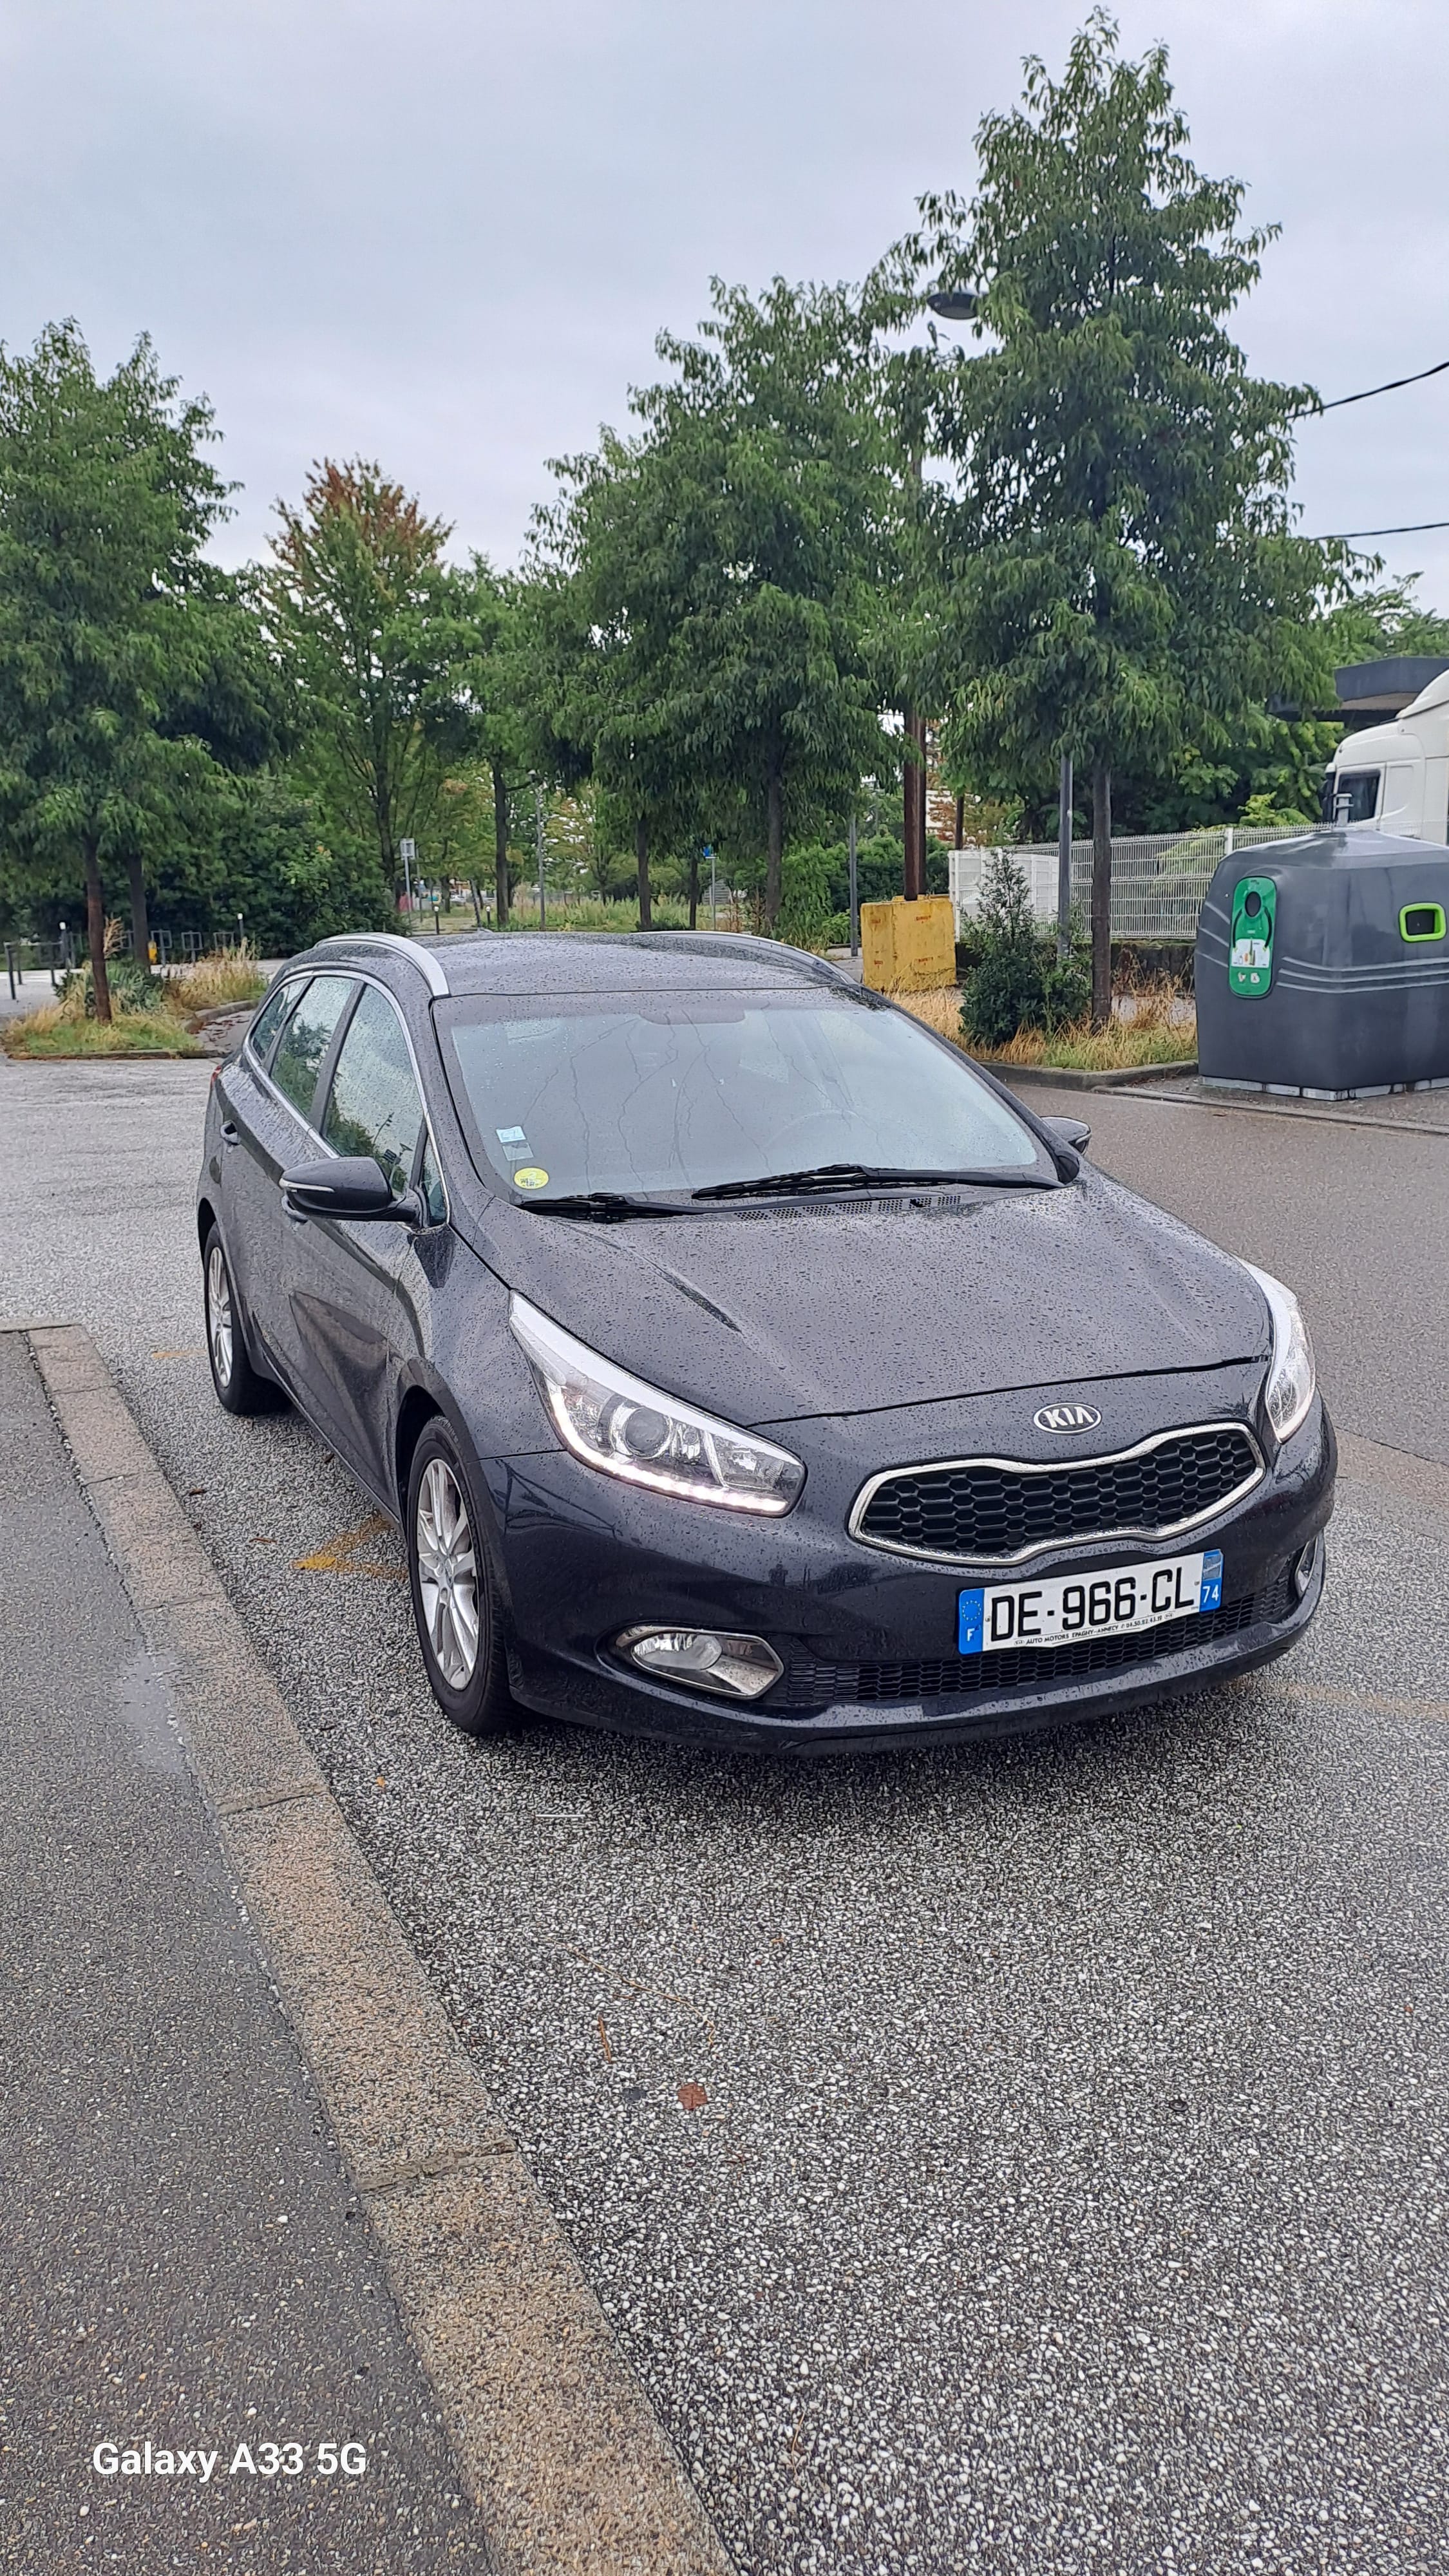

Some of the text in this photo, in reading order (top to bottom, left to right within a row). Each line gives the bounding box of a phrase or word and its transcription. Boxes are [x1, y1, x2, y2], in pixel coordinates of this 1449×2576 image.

[1043, 1406, 1094, 1428] KIA
[990, 1566, 1195, 1642] DE-966-CL
[1202, 1584, 1219, 1604] 74
[967, 1627, 976, 1642] F
[1045, 1634, 1069, 1642] MOTORS
